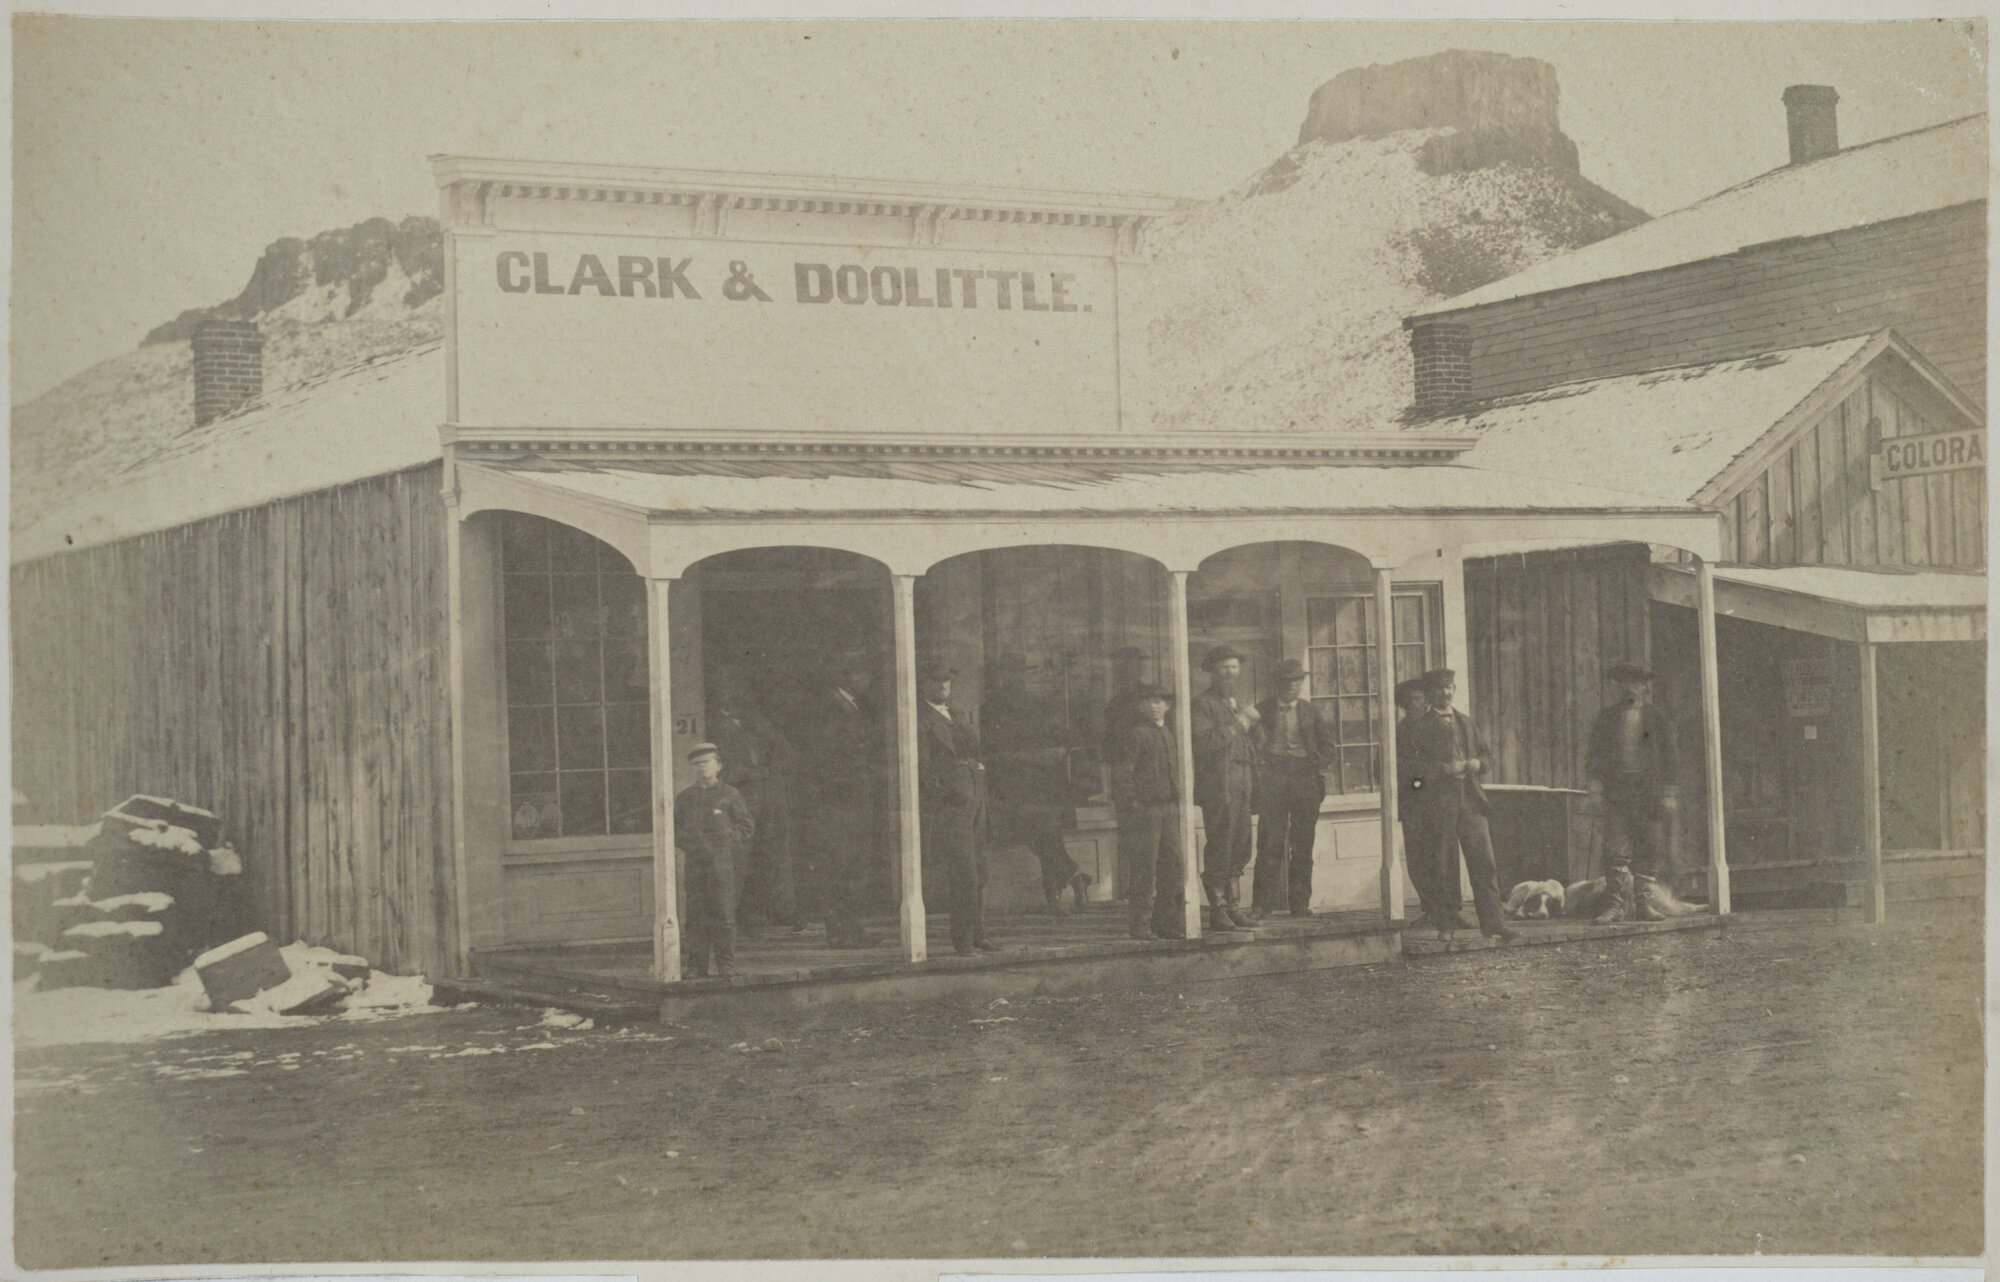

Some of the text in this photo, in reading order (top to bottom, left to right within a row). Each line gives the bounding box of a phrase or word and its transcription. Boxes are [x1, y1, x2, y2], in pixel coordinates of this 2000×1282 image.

[496, 250, 1093, 313] CLARK & DOOLITTLE.
[1886, 434, 1983, 472] COLORA
[676, 718, 697, 734] 21
